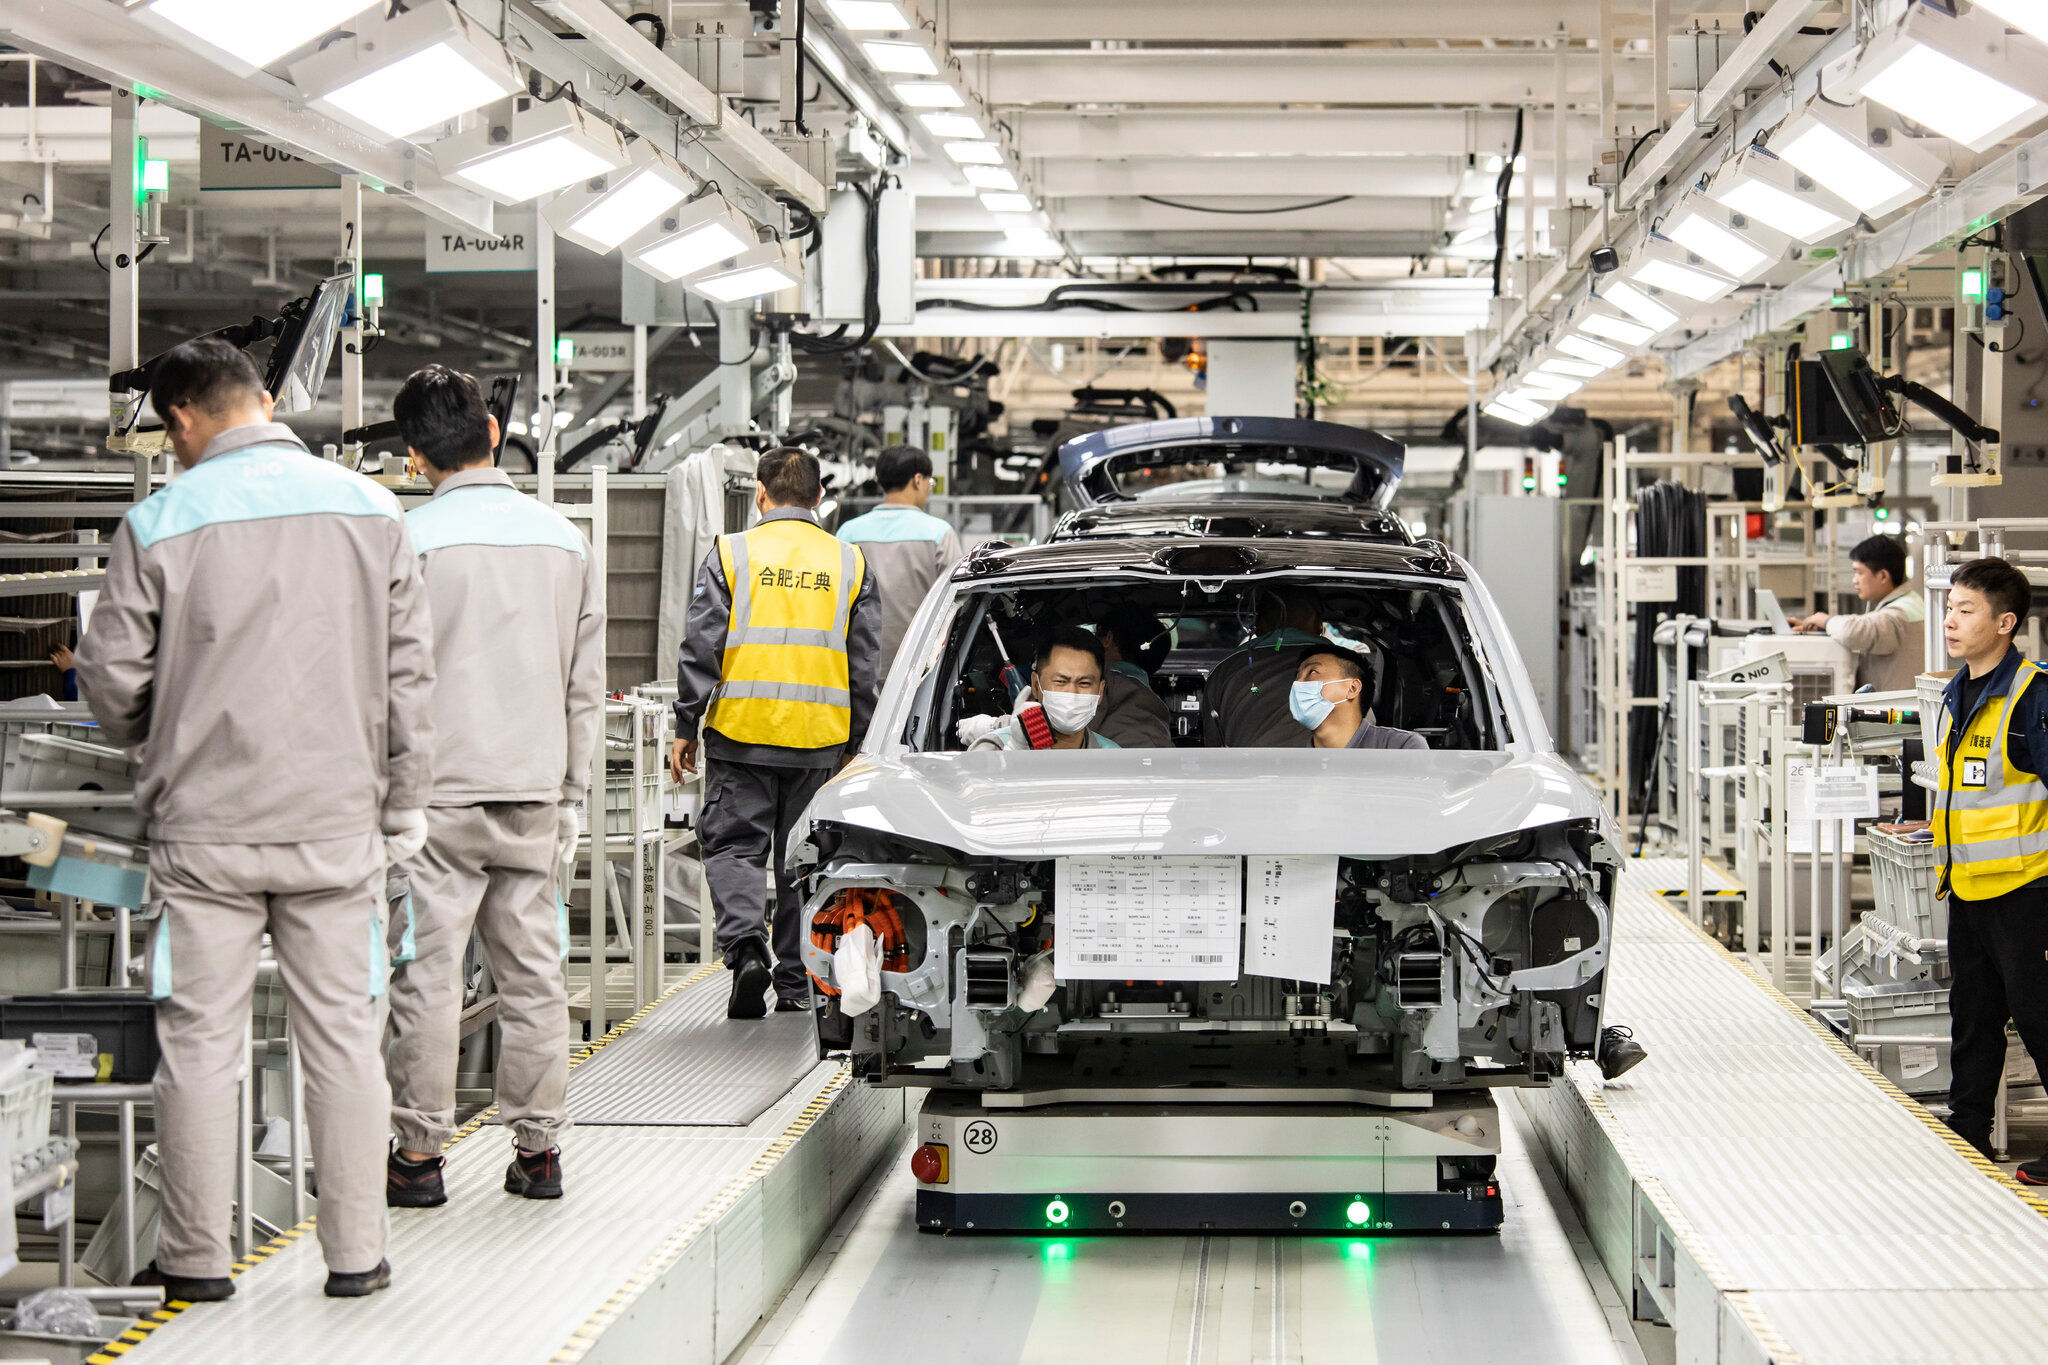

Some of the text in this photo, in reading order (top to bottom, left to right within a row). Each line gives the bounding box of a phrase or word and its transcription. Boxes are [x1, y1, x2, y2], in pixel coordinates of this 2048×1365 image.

[759, 566, 831, 592] 合肥汇典
[1748, 666, 1770, 680] NIO
[644, 919, 654, 937] 003
[969, 1129, 992, 1145] 28
